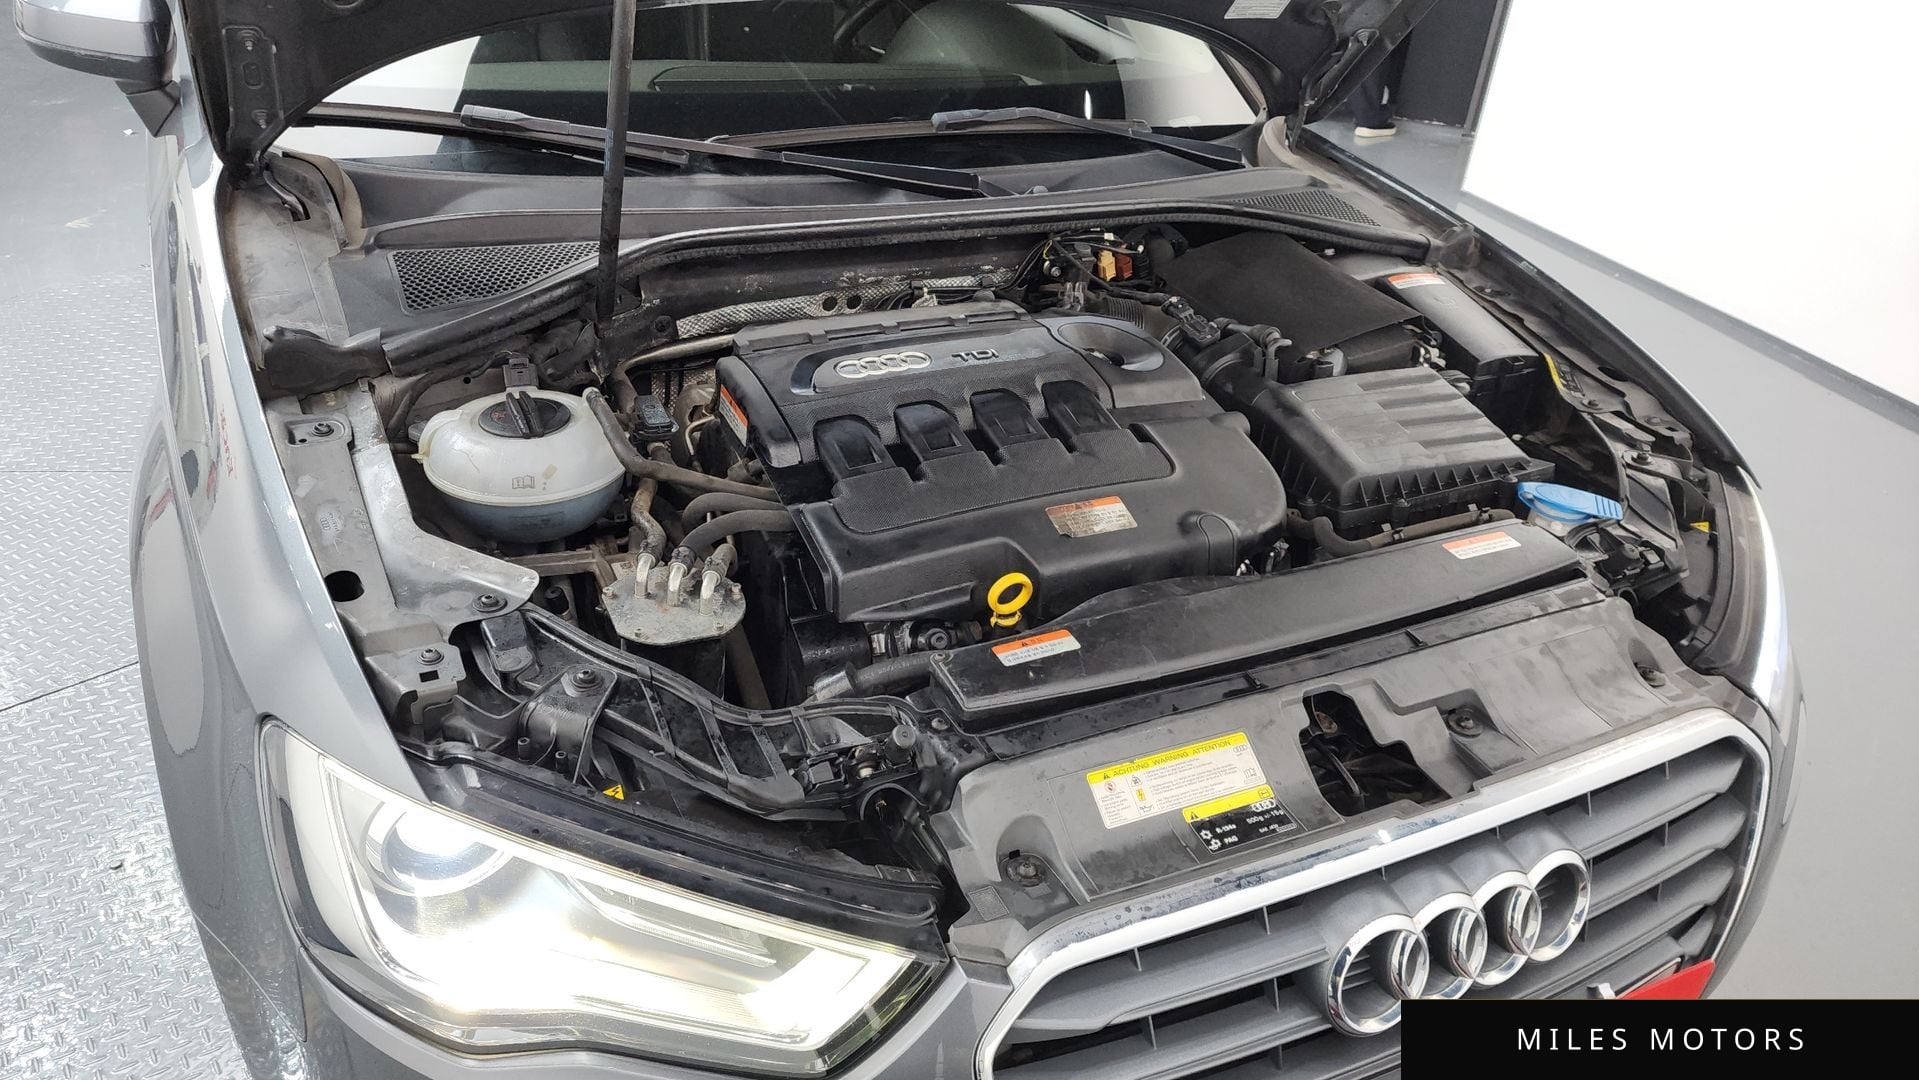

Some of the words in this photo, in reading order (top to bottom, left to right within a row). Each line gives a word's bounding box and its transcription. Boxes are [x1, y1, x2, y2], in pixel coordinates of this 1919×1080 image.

[951, 348, 1000, 362] TDI
[1113, 761, 1150, 777] ACHTUNG
[1152, 750, 1189, 766] WARNING
[1192, 739, 1232, 755] ATTENTION
[1224, 835, 1239, 845] PAG
